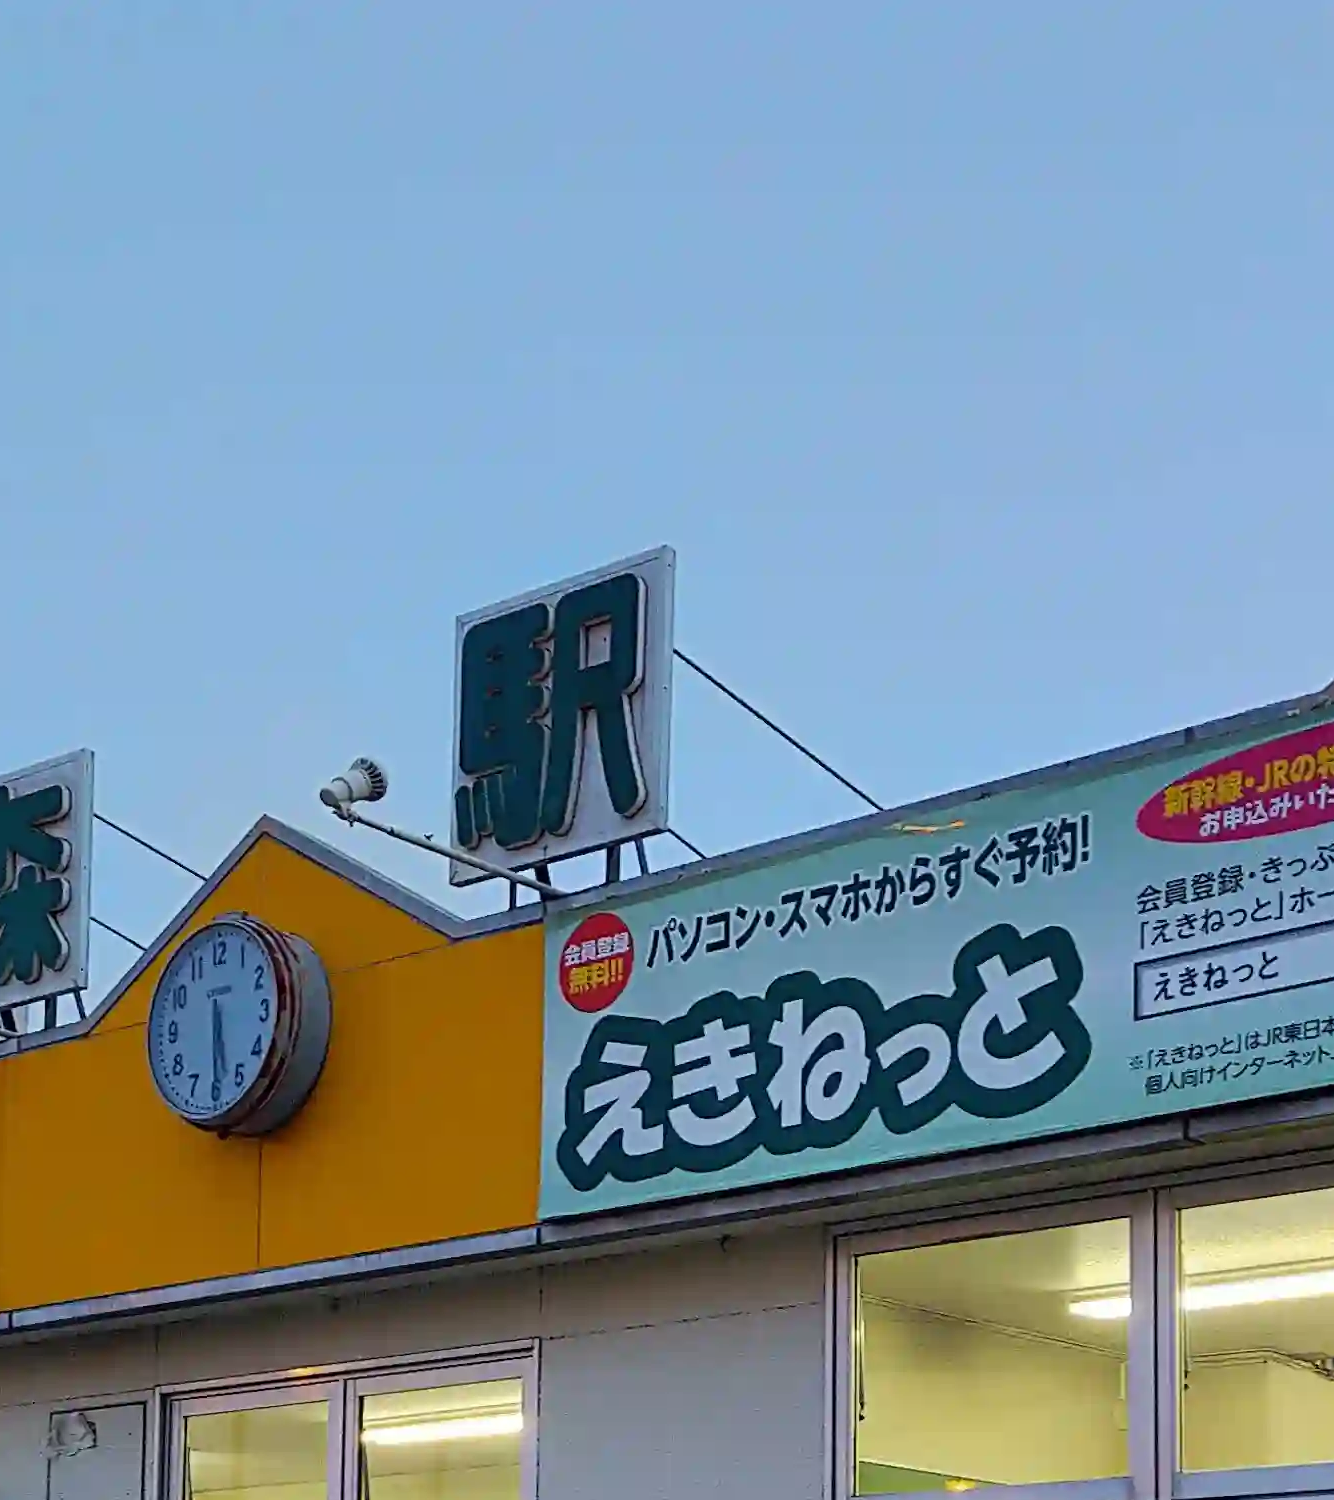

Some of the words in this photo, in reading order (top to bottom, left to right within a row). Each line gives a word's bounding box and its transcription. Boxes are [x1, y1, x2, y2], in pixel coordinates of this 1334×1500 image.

[455, 572, 648, 850] 駅
[647, 815, 1090, 968] パソコン・スマホからすぐ予約!
[213, 942, 226, 966] 12
[240, 944, 245, 968] 1
[564, 932, 630, 966] 会員登録
[191, 955, 203, 982] 11
[253, 965, 264, 991] 2
[1154, 952, 1279, 1001] えきねっと
[173, 984, 187, 1011] 10
[259, 998, 269, 1022] 3
[169, 1020, 178, 1044] 9
[251, 1034, 262, 1056] 4
[172, 1053, 184, 1075] 8
[573, 950, 1069, 1167] えきねっと
[187, 1074, 199, 1097] 7
[235, 1063, 245, 1088] 5
[211, 1079, 221, 1102] 6
